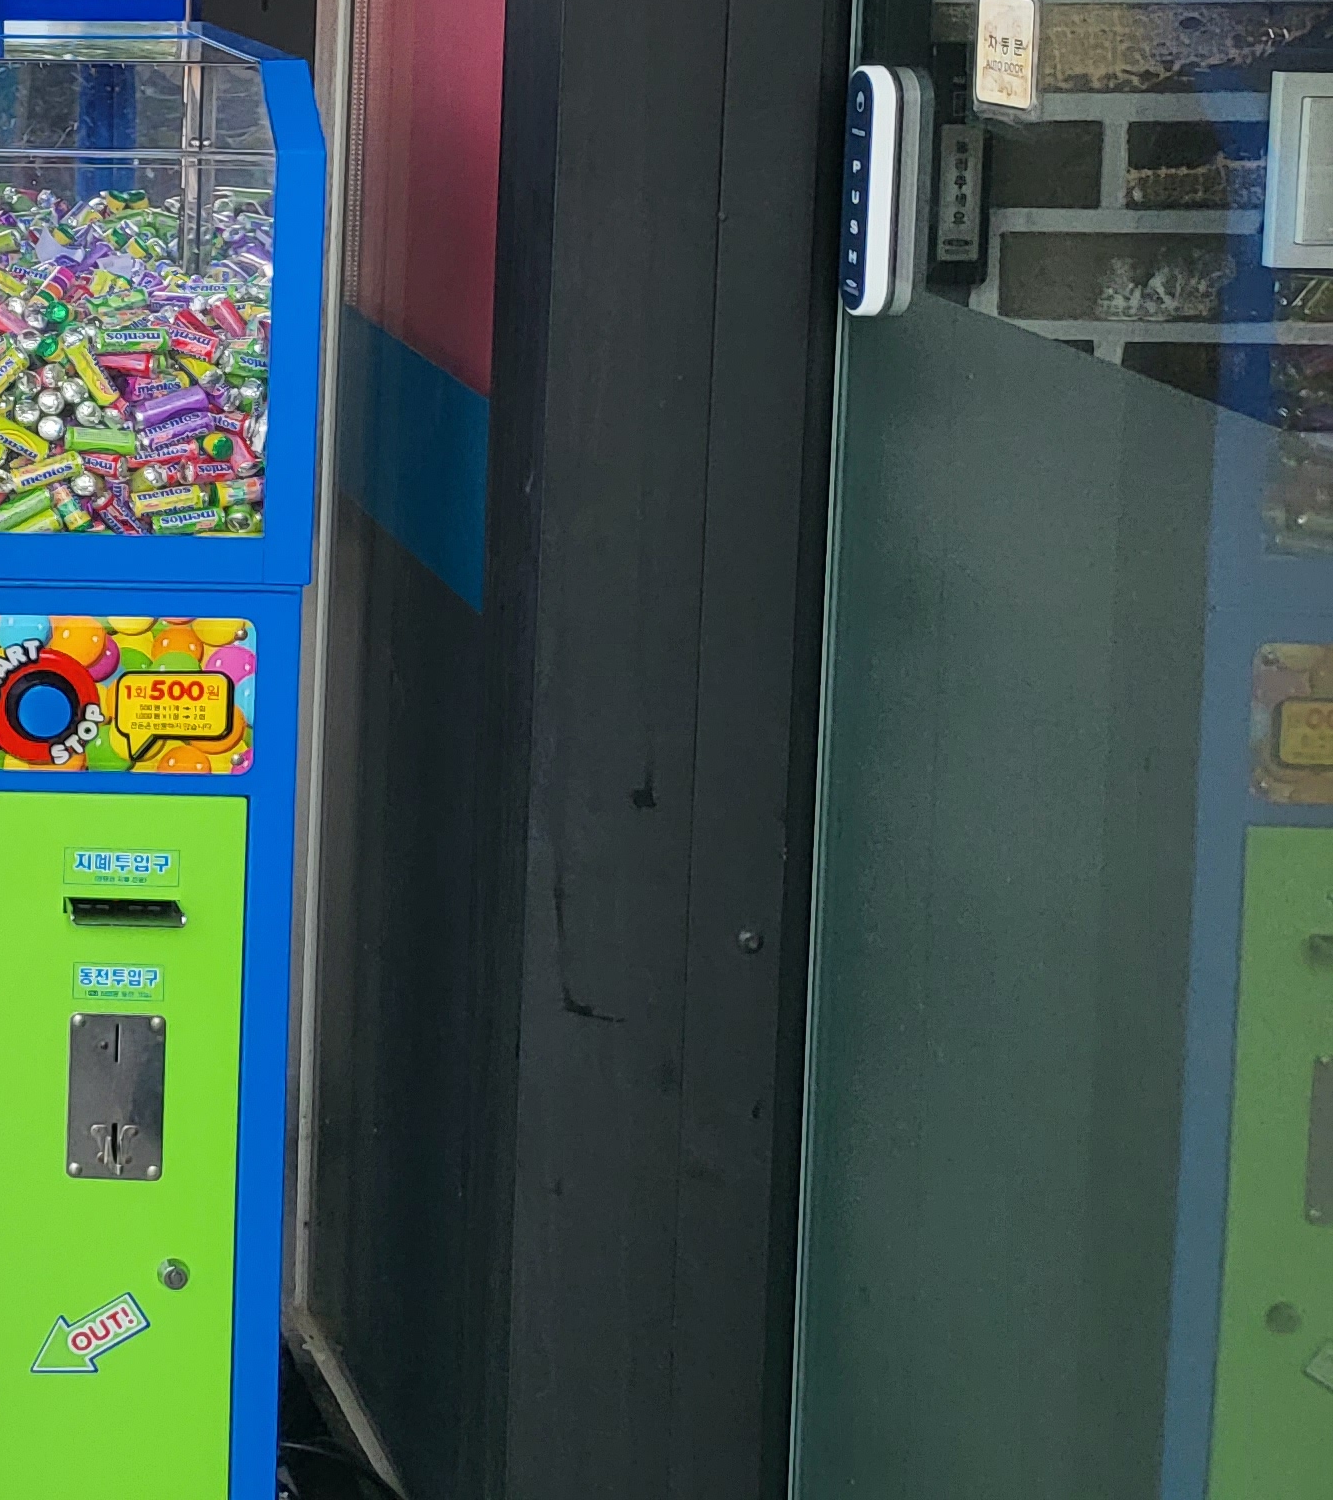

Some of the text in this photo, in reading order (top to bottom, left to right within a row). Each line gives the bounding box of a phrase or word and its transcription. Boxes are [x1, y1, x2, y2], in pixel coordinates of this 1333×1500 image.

[988, 35, 1023, 56] 자동문
[848, 161, 862, 265] PUSH
[106, 332, 162, 342] mentos
[137, 382, 181, 394] mentos
[145, 412, 202, 436] mentos
[21, 463, 73, 487] mentos
[137, 486, 191, 501] mentos
[161, 510, 216, 525] mentos
[50, 704, 106, 764] STOP
[74, 852, 171, 873] 지폐투입구
[79, 968, 159, 987] 동전투입구
[70, 1305, 136, 1353] OUT!
